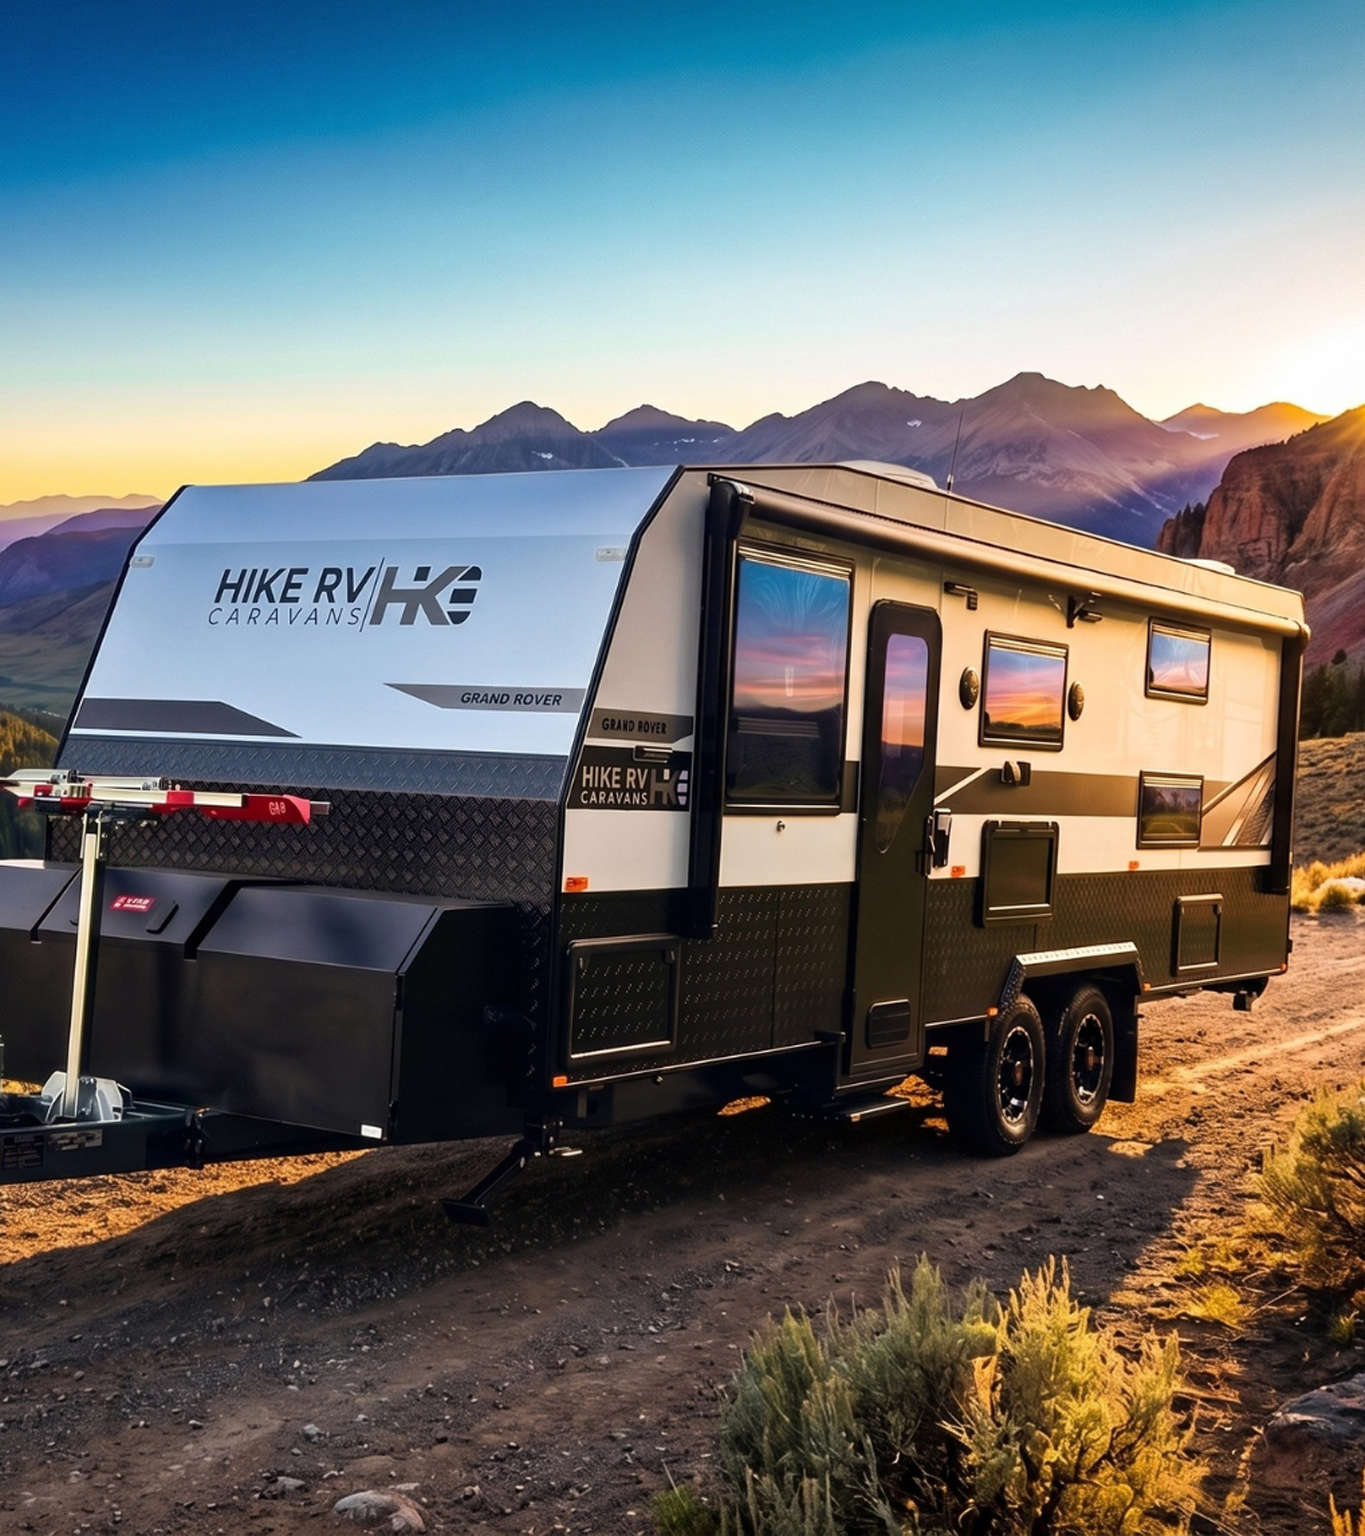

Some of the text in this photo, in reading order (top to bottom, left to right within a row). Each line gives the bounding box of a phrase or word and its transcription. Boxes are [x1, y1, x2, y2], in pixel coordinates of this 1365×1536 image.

[214, 566, 377, 604] HIKE RV
[207, 607, 363, 626] CARAVANS
[460, 692, 563, 706] GRAND ROVER
[601, 718, 667, 734] GRAND ROVER
[582, 766, 648, 789] HIKE RV
[580, 790, 648, 805] CARAVANS
